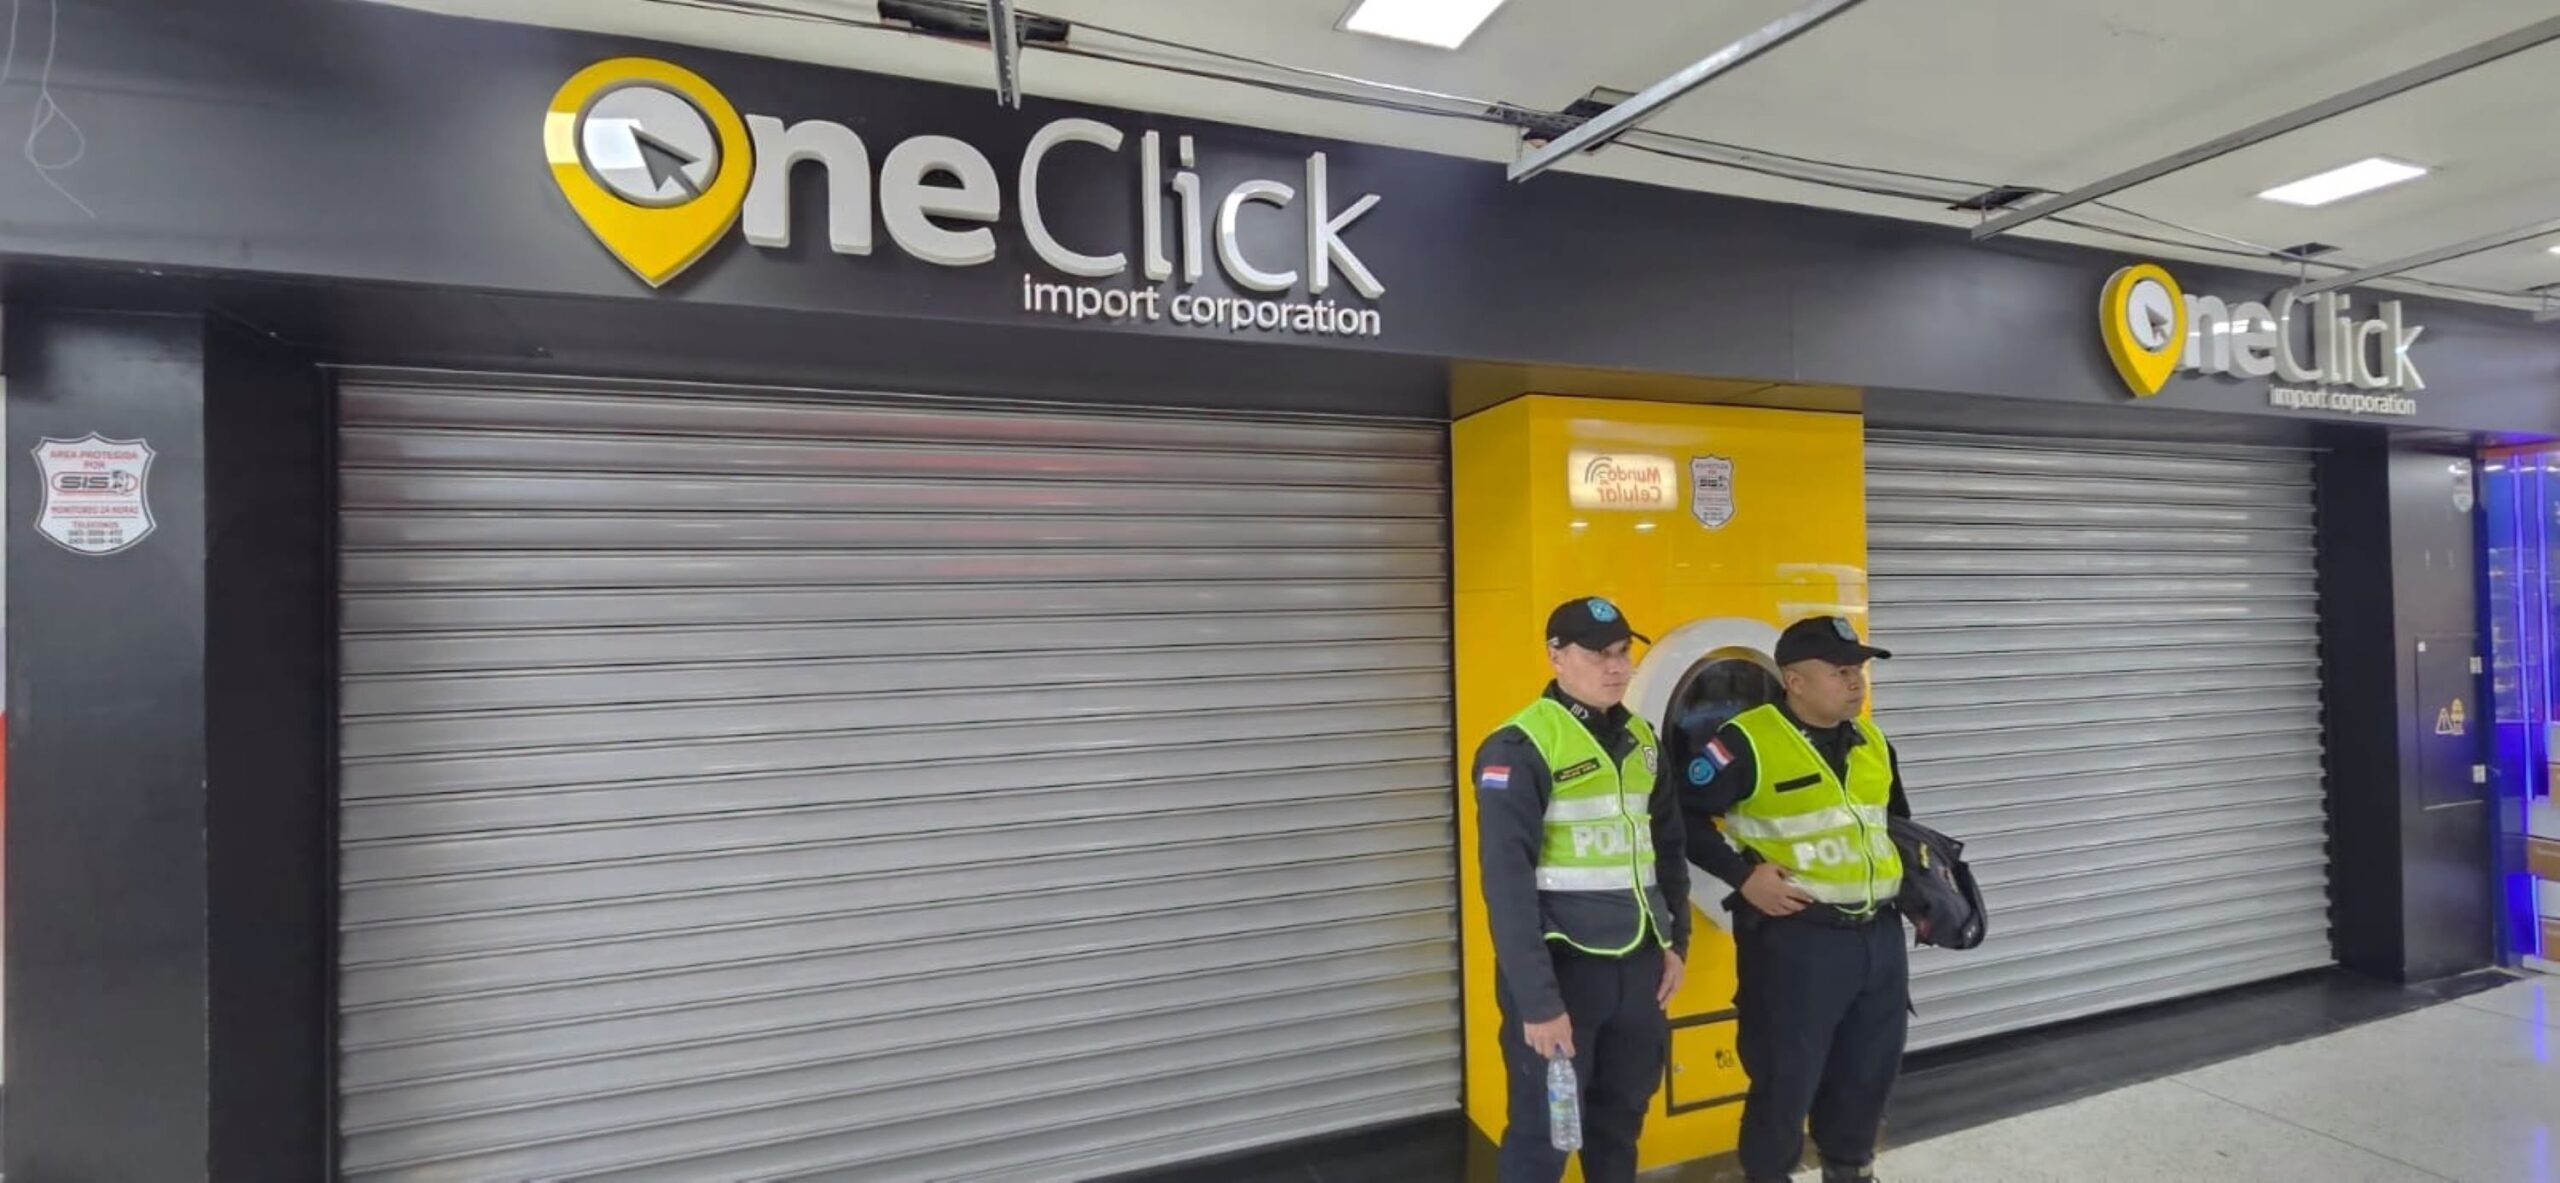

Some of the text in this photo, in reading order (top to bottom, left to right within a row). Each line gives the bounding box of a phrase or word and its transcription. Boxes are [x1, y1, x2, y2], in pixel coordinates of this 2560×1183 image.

[1023, 273, 1381, 336] import corporation
[2269, 384, 2417, 415] import corporation
[60, 475, 110, 489] SIS
